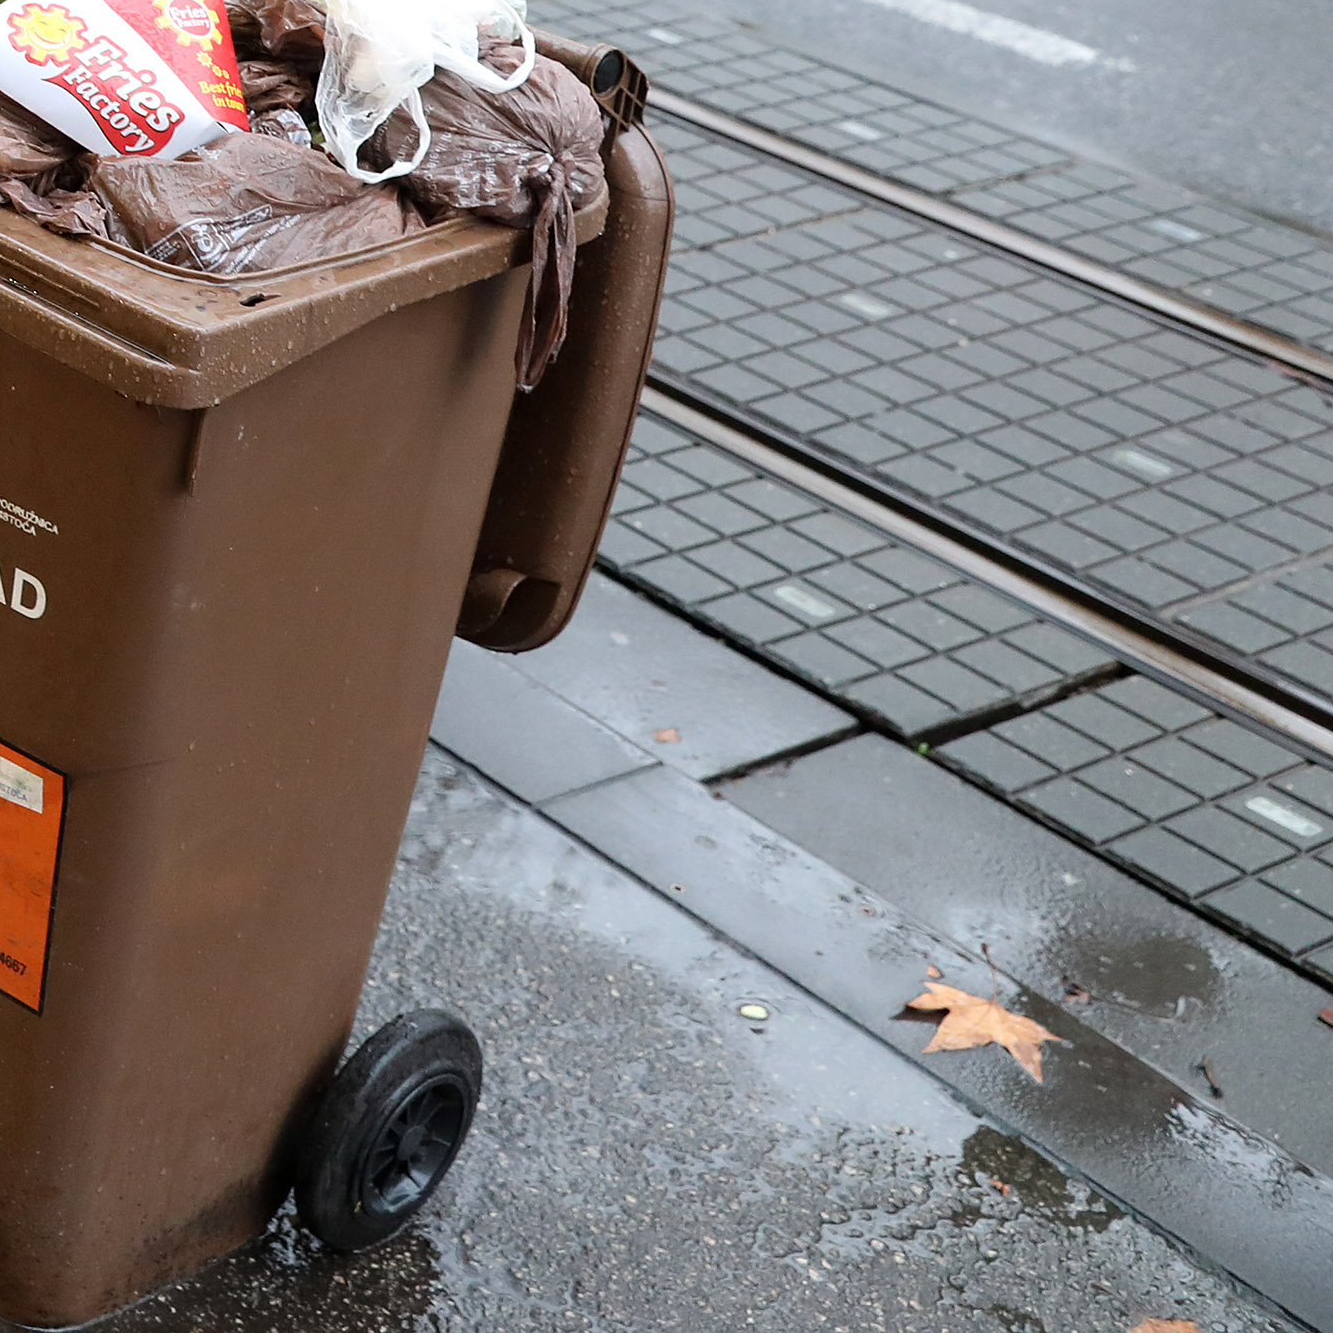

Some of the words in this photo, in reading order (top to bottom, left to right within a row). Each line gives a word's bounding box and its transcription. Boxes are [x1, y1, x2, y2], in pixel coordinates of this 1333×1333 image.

[62, 66, 156, 153] Factory
[74, 38, 182, 132] Fries
[198, 80, 226, 95] Best
